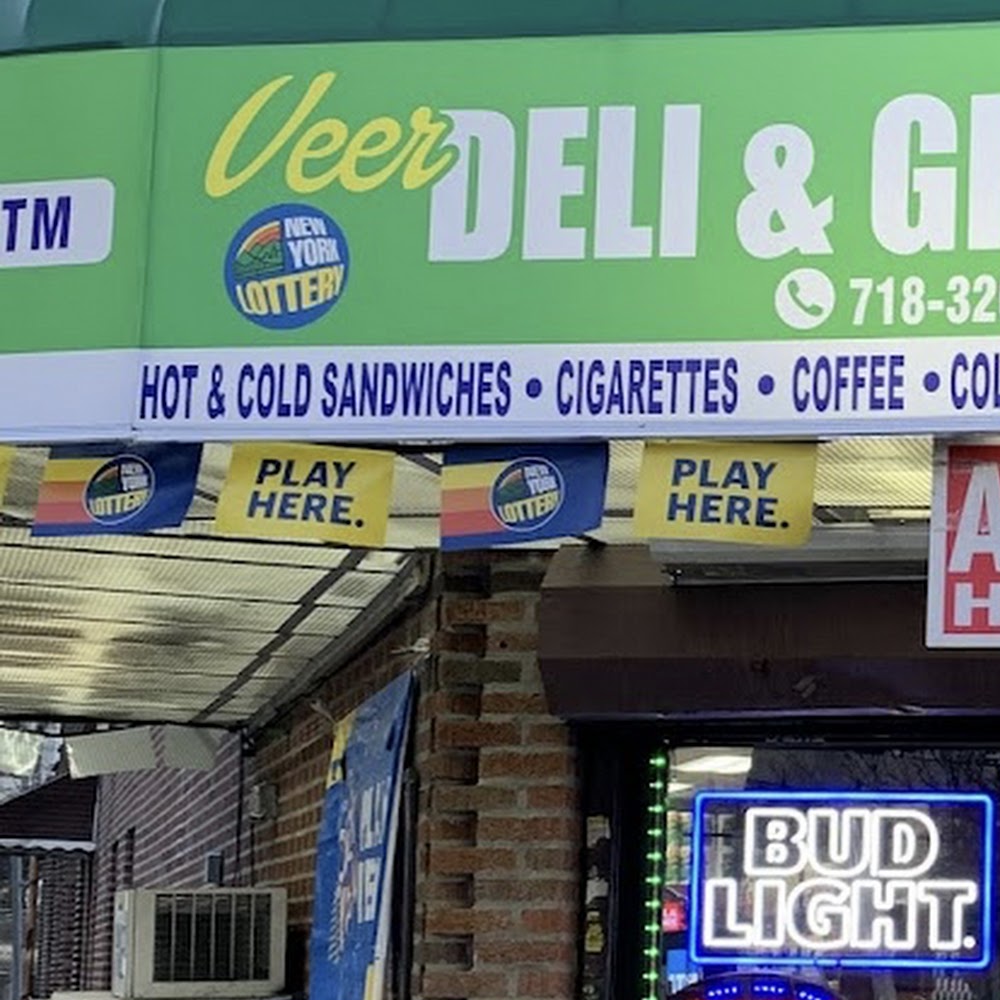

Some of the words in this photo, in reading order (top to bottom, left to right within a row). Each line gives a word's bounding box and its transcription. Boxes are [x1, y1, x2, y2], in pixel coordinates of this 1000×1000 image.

[204, 71, 459, 198] Veer
[427, 103, 702, 262] DELI
[736, 123, 834, 259] &
[285, 216, 327, 238] NEW
[287, 237, 341, 268] YORK
[236, 263, 345, 315] LOTTERY
[140, 364, 199, 421] HOT
[207, 366, 226, 418] &
[237, 363, 311, 420] COLD
[321, 359, 512, 418] SANDWICHES
[556, 357, 738, 416] CIGARETTES
[792, 354, 905, 413] COFFEE
[256, 459, 357, 490] PLAY
[672, 458, 778, 490] PLAY
[246, 490, 365, 528] HERE.
[666, 492, 789, 529] HERE.
[744, 807, 940, 878] BUD
